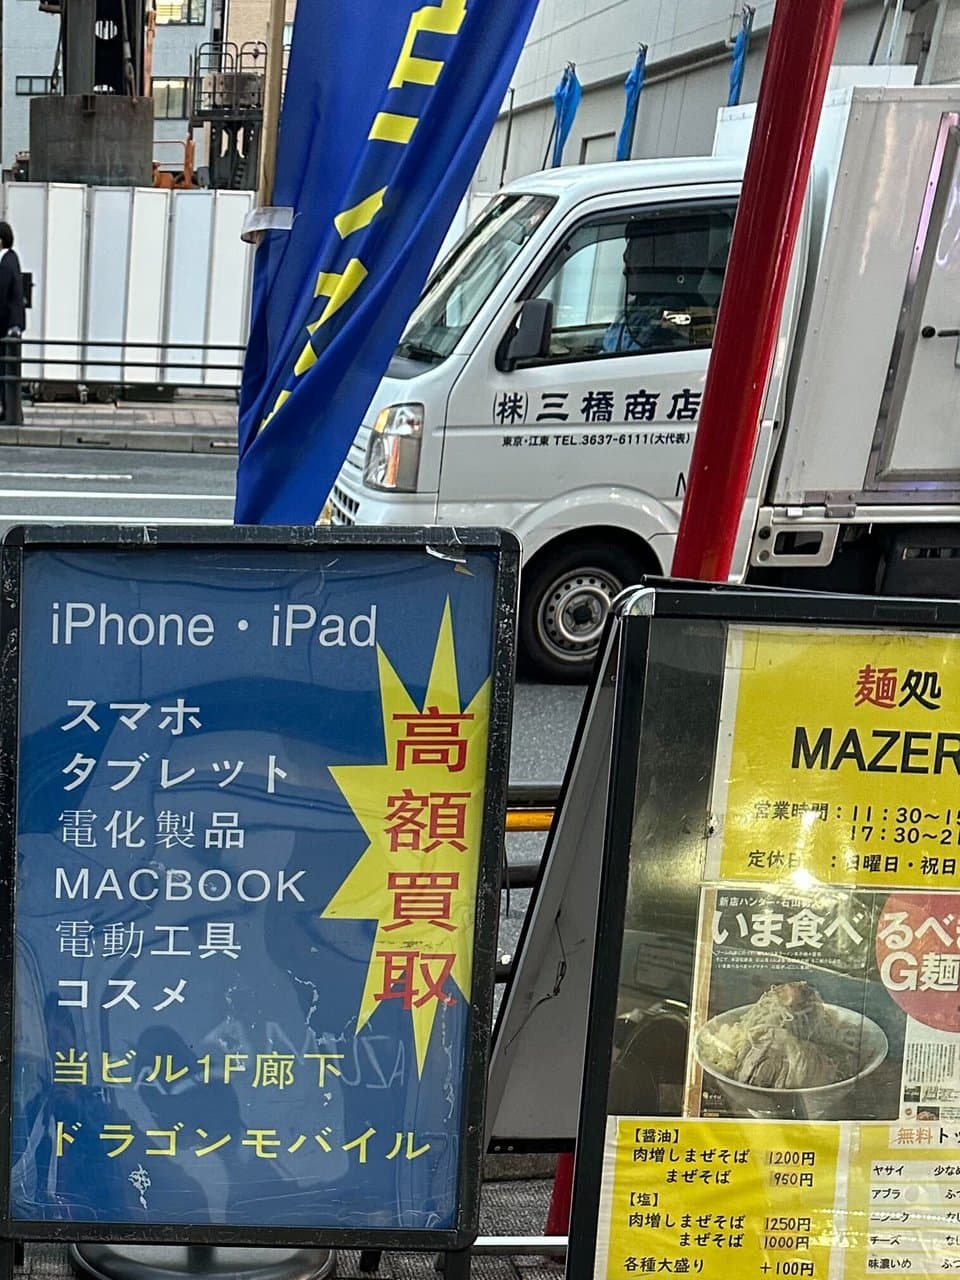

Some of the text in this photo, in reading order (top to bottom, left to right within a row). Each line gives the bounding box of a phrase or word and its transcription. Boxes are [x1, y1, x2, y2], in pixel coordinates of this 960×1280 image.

[51, 602, 215, 647] iPhone
[271, 603, 378, 648] iPad
[855, 663, 942, 711] 麺処
[60, 698, 203, 736] スマホ
[791, 725, 960, 775] MAZER
[60, 752, 288, 794] タブレット
[58, 808, 246, 850] 電化製品
[373, 706, 475, 1011] 高額買取
[54, 868, 307, 903] MACBOOK
[54, 919, 242, 960] 電動工具
[56, 978, 189, 1012] コスメ
[53, 1048, 345, 1090] 当ビル1F廊下
[55, 1121, 431, 1164] ドラゴンモバイル
[633, 1147, 816, 1167] 肉増しまぜそば 1200円
[666, 1169, 814, 1188] まぜそば 950円
[873, 1165, 905, 1176] ヤサイ
[872, 1188, 901, 1200] アブラ
[628, 1212, 811, 1232] 肉増しまぜそば 1250円
[679, 1233, 810, 1251] まぜそば 1000円
[624, 1257, 705, 1274] 各種大盛り
[868, 1257, 912, 1270] 味濃いめ
